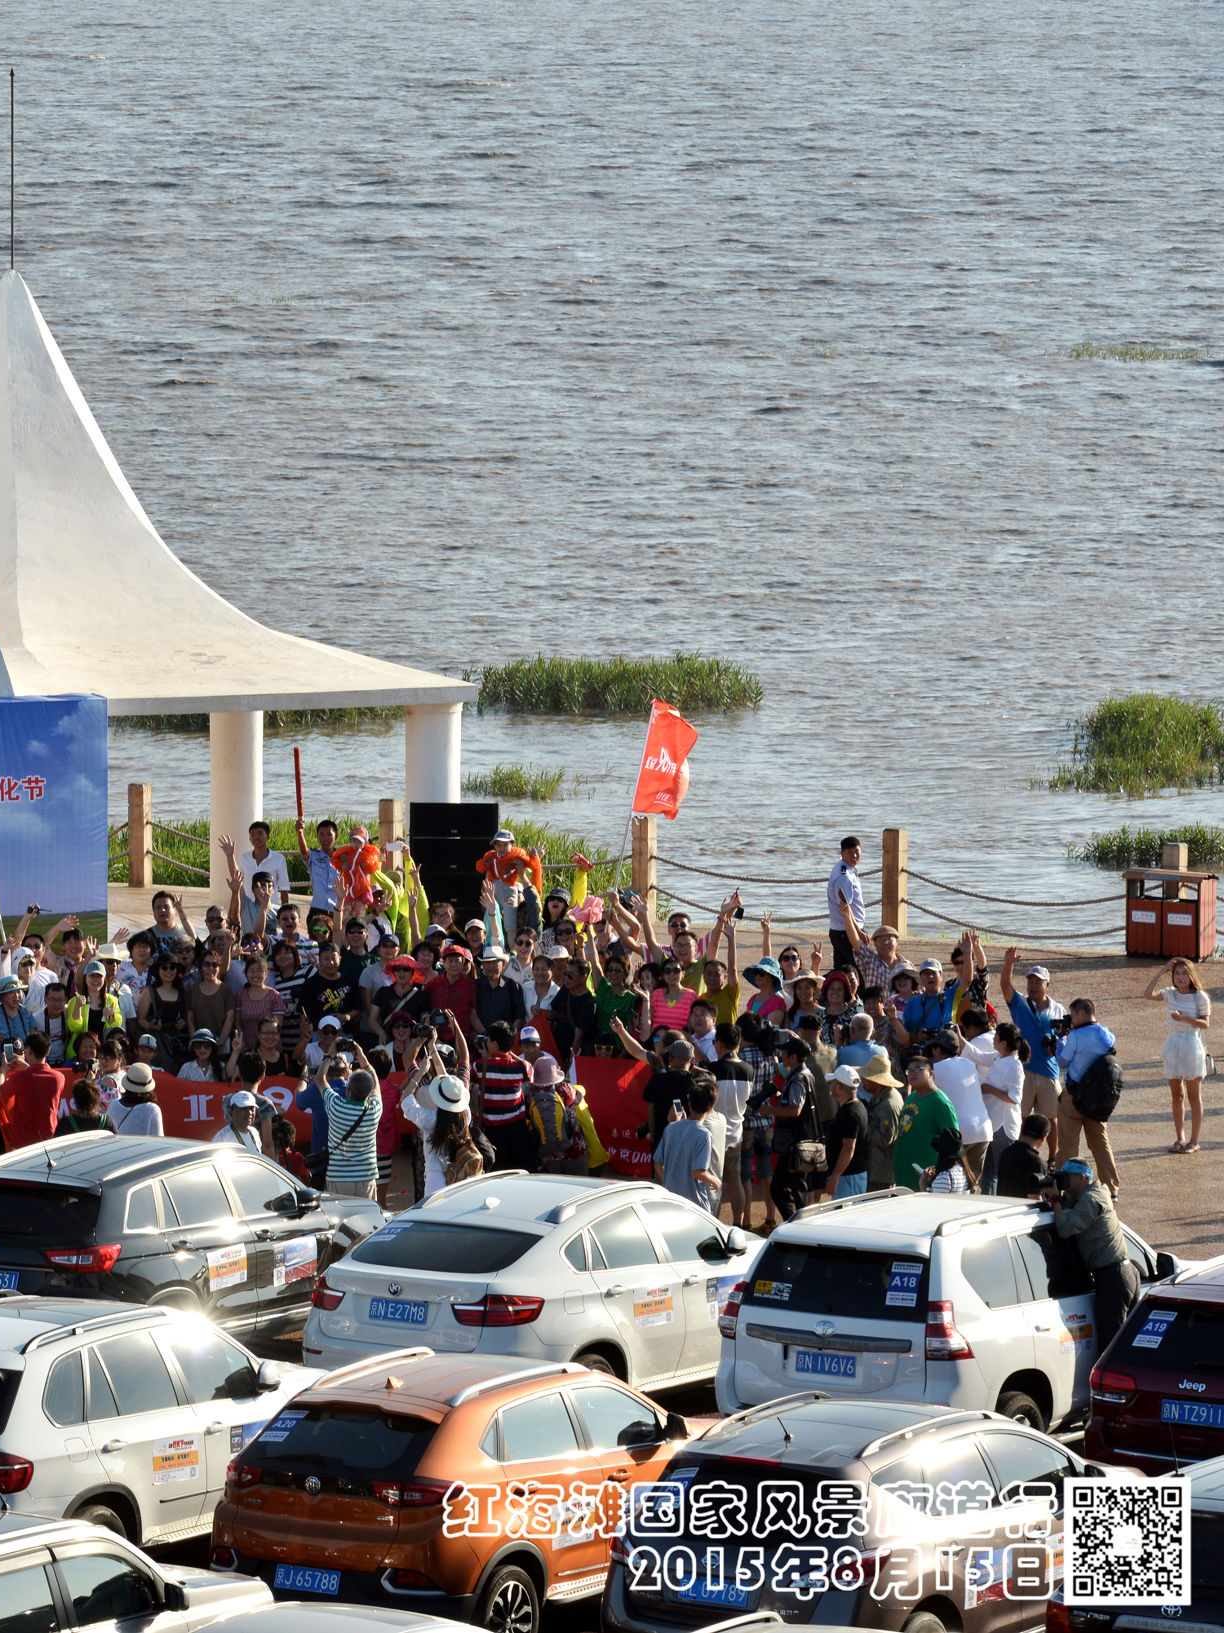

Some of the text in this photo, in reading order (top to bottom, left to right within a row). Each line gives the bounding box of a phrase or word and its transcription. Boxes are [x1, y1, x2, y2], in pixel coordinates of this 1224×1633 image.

[891, 1275, 917, 1288] A18
[1143, 1321, 1167, 1333] A19
[1178, 1379, 1207, 1393] Jeep
[271, 1419, 297, 1429] A20
